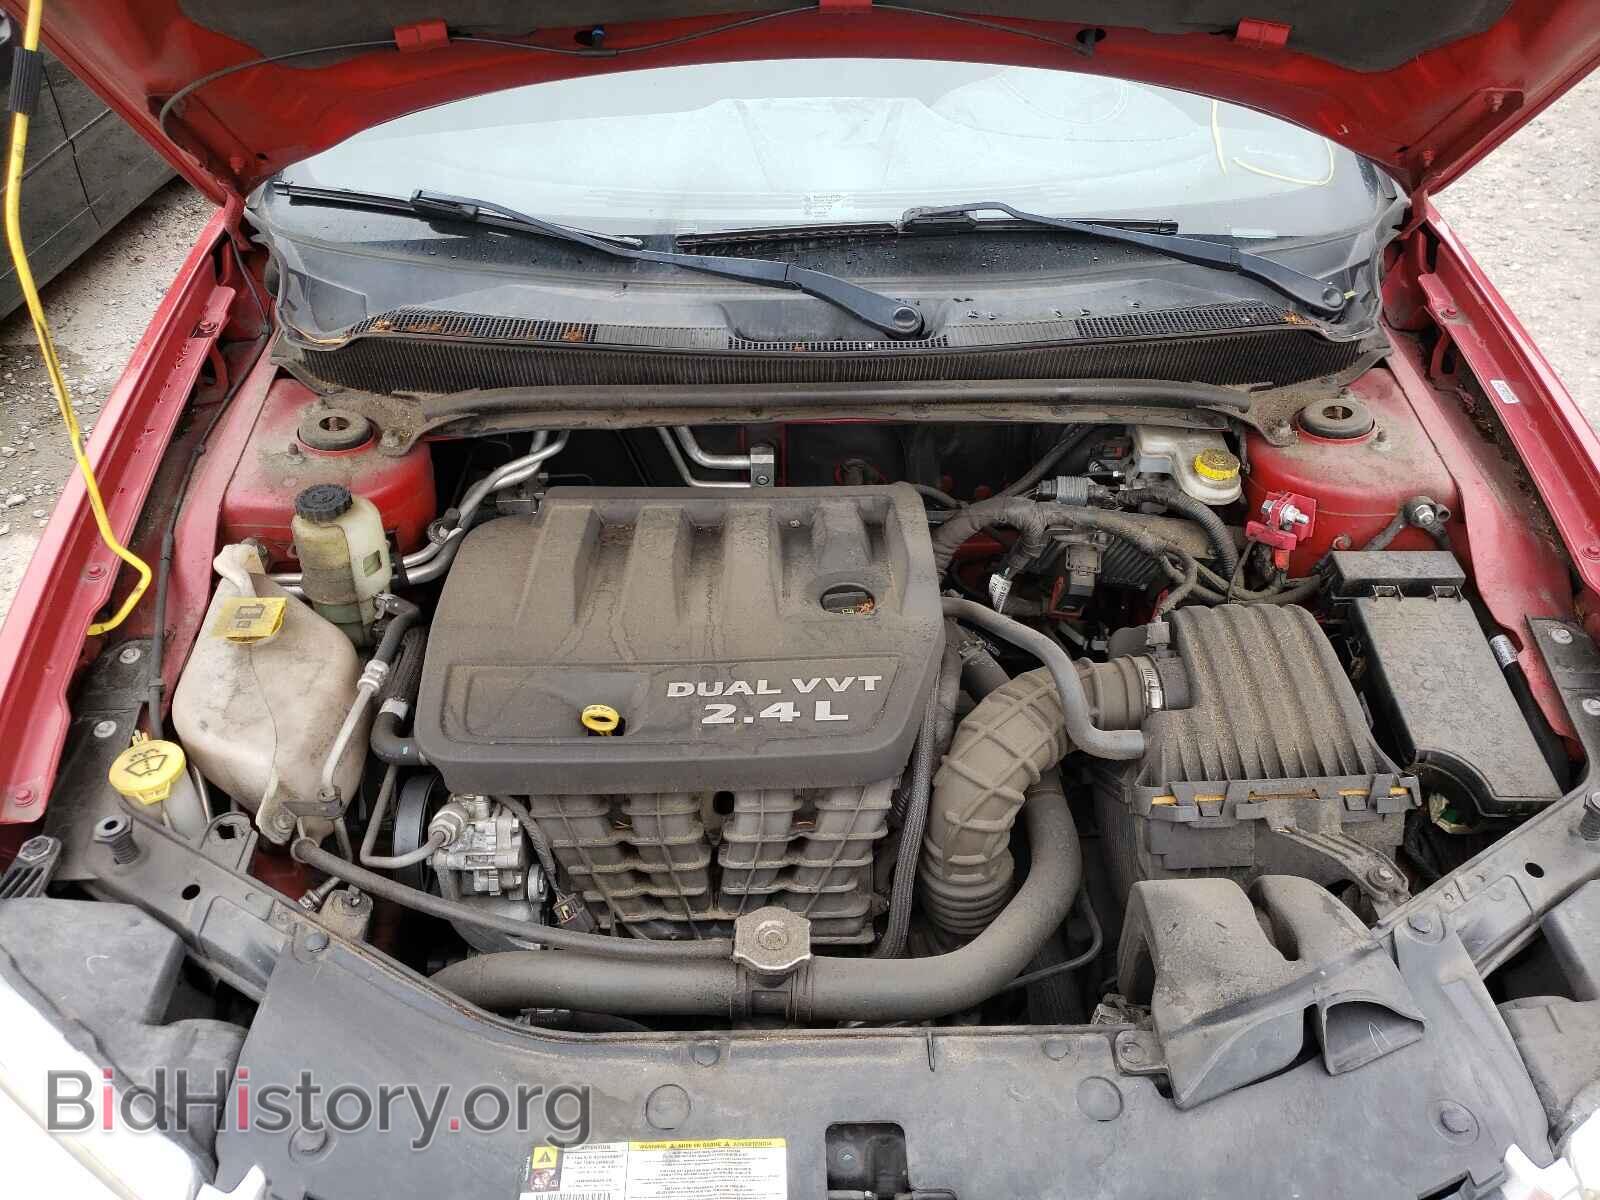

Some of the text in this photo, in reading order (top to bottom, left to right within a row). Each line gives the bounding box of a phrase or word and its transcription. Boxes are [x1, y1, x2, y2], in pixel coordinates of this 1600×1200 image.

[667, 675, 882, 697] DUAL VVT
[701, 700, 849, 724] 2.4 L
